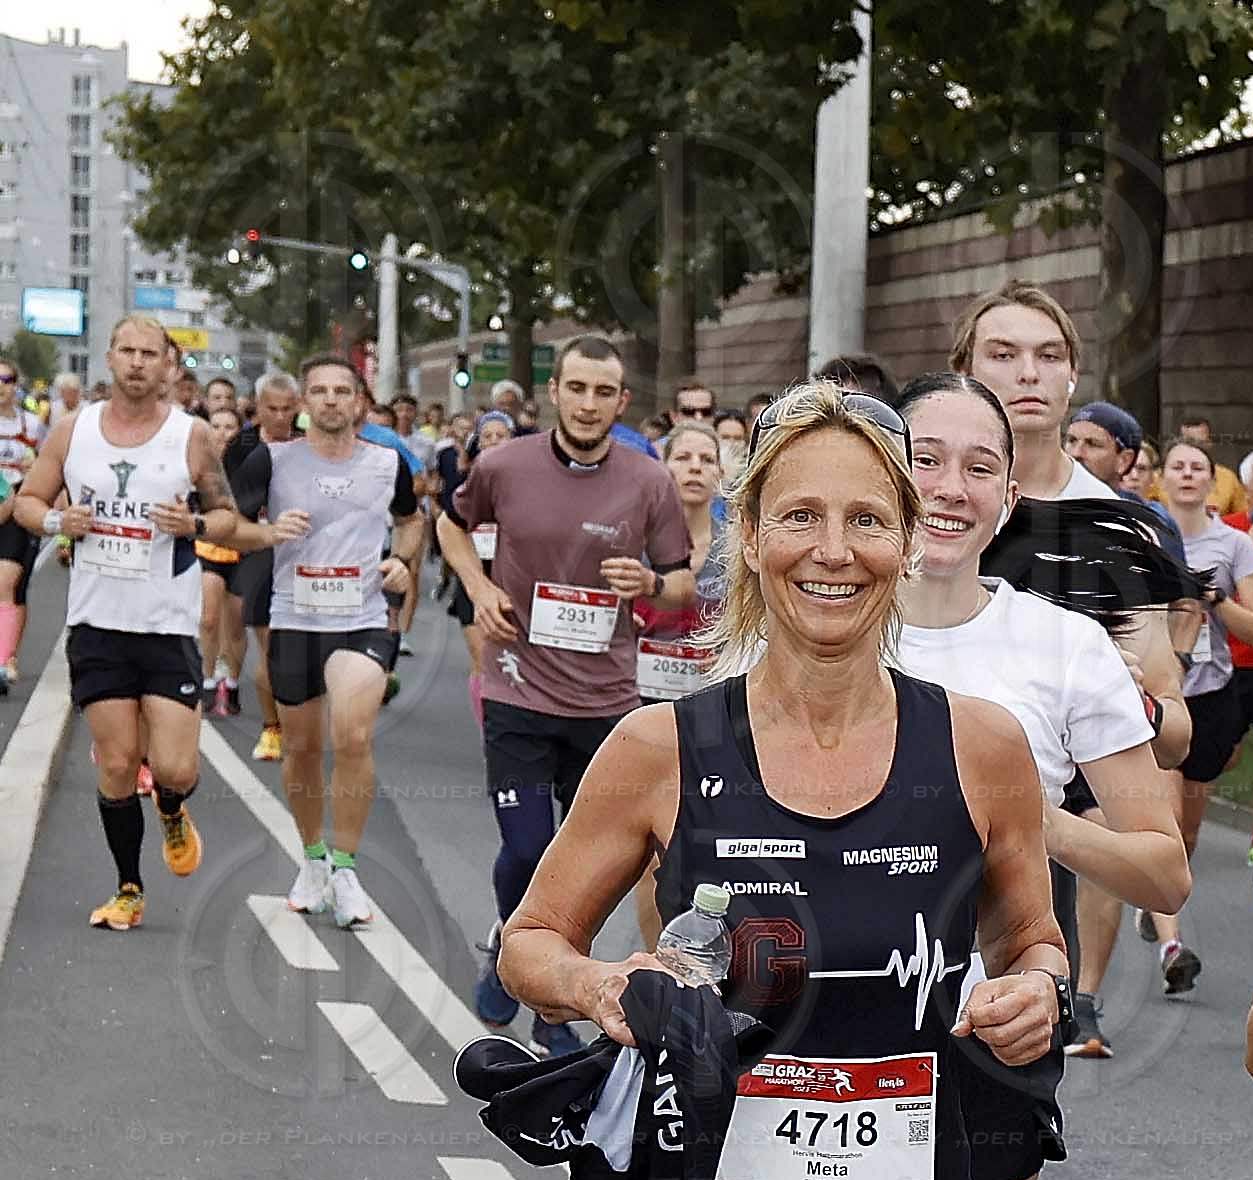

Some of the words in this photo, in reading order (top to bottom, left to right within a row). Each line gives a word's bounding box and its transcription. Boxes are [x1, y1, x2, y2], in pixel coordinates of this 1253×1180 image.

[557, 606, 596, 625] 2931
[728, 842, 758, 854] giga
[763, 843, 802, 854] sport
[843, 846, 938, 866] MAGNESIUM
[887, 861, 937, 876] SPORT
[721, 881, 808, 895] ADMIRAL
[775, 1065, 816, 1078] GRAZ
[775, 1110, 878, 1148] 4718
[807, 1161, 848, 1176] Meta
